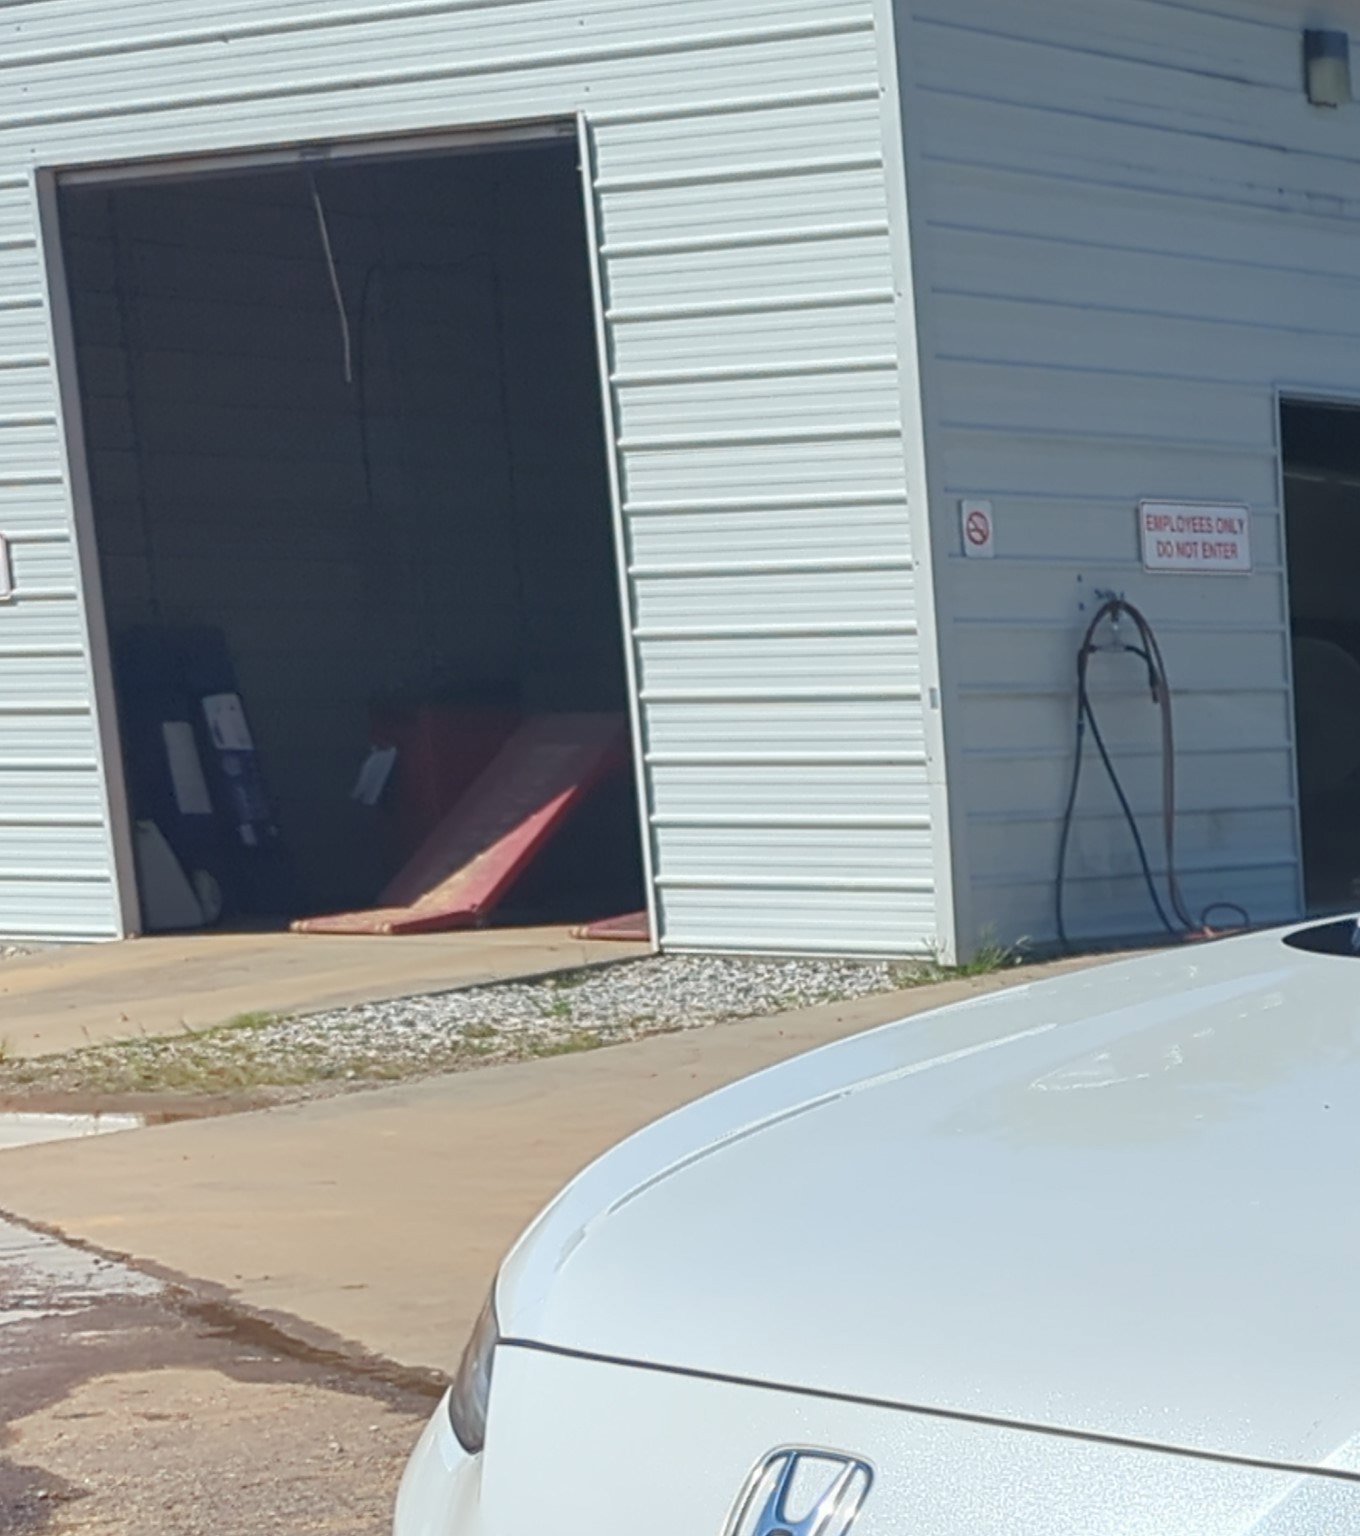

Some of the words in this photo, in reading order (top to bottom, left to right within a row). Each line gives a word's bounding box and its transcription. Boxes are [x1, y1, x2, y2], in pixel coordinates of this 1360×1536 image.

[1146, 514, 1213, 533] EMPLOYEES
[1216, 516, 1244, 535] ONLY
[1156, 540, 1174, 558] DO
[1176, 541, 1199, 558] NOT
[1202, 541, 1238, 559] ENTER
